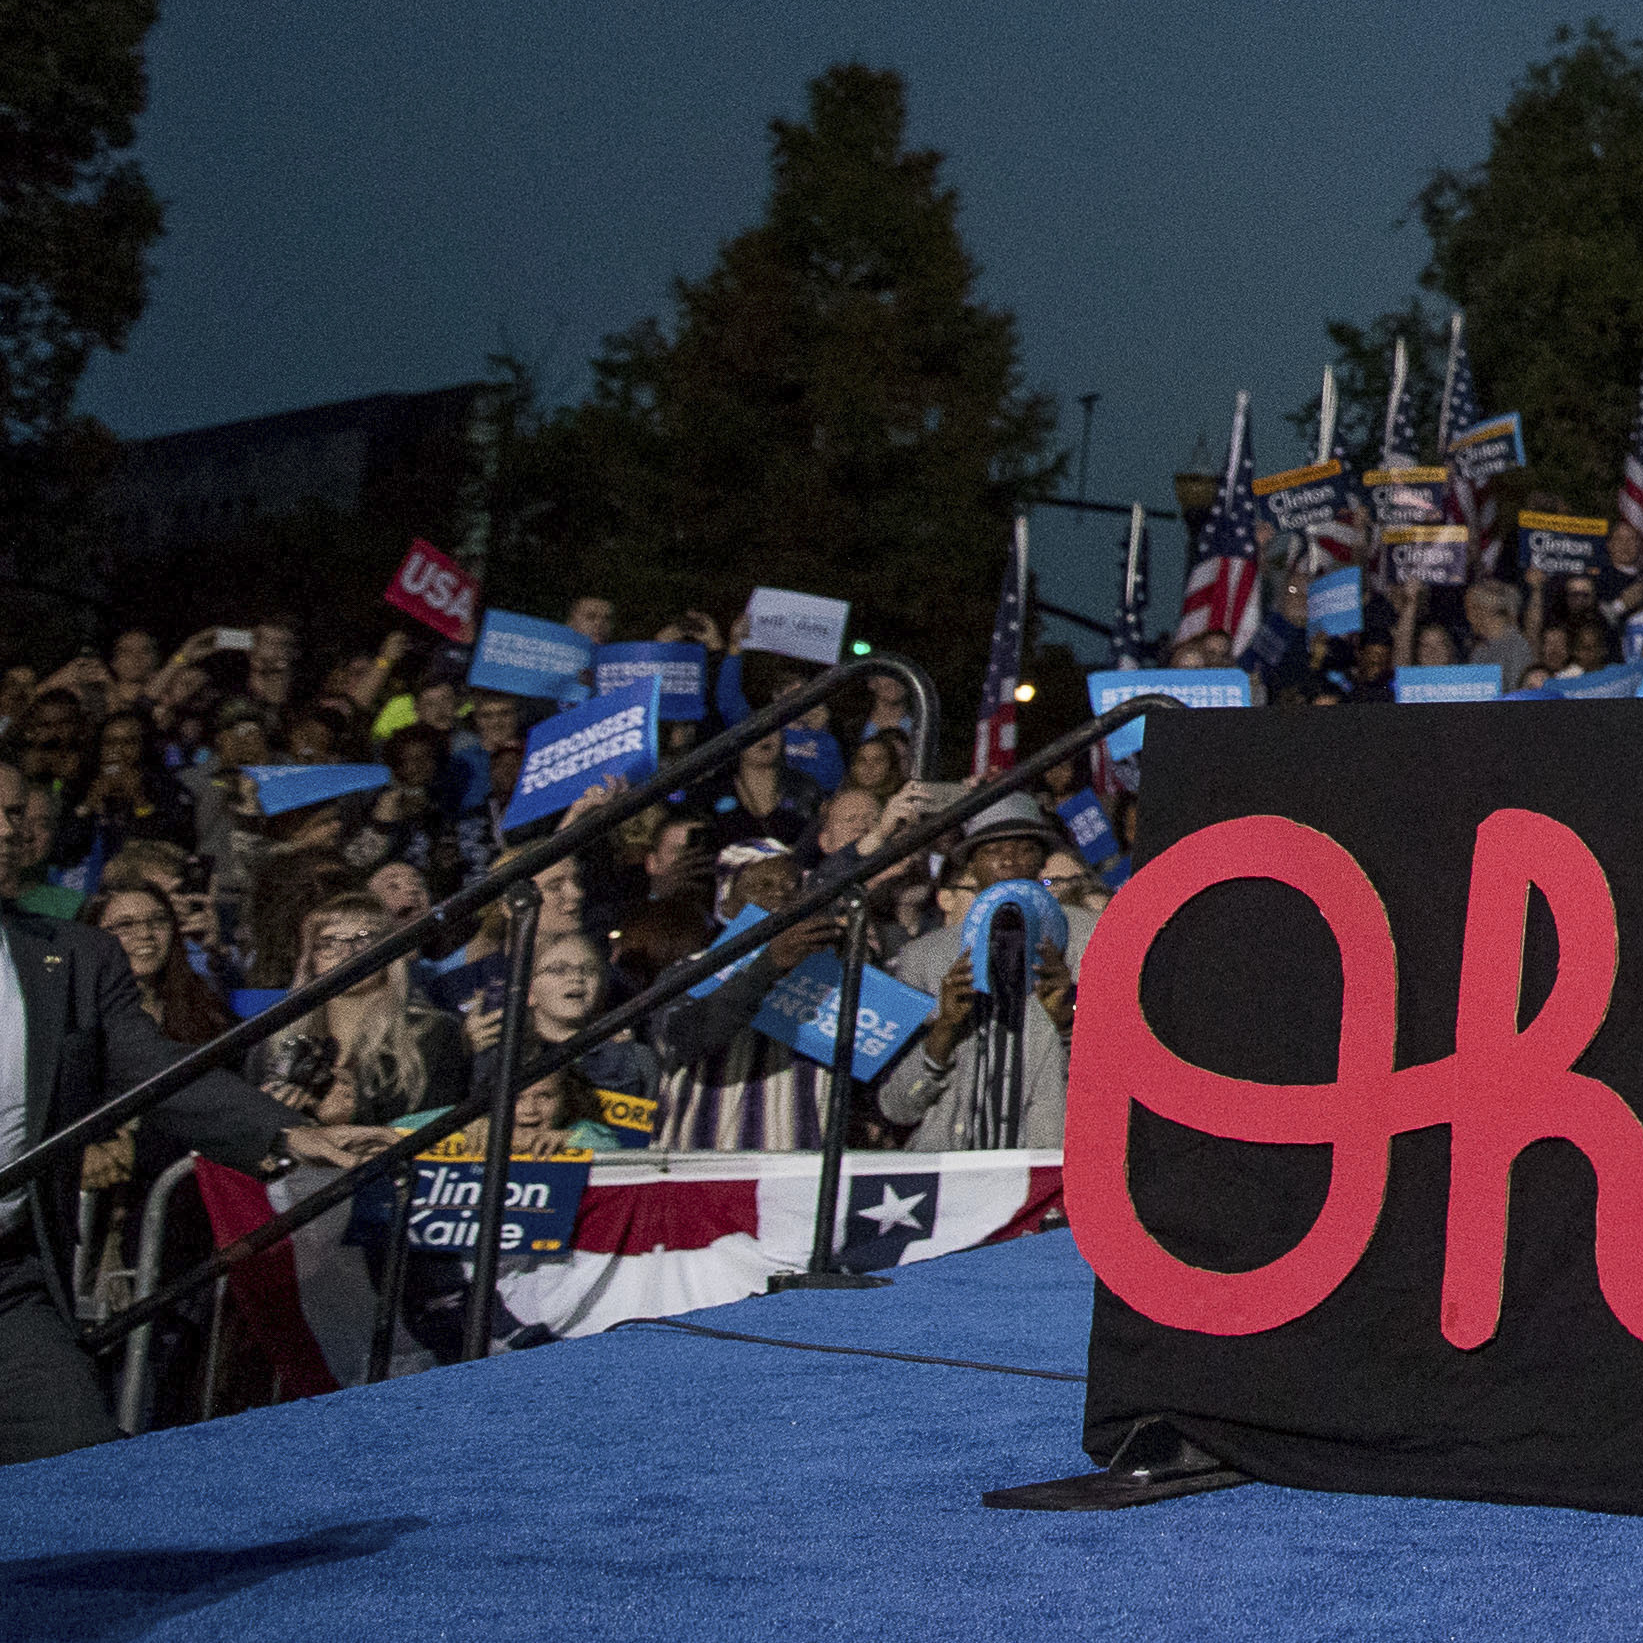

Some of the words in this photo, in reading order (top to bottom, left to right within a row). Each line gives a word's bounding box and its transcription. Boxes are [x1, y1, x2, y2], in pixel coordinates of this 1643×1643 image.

[400, 553, 474, 622] USA
[521, 729, 644, 796] TOGETHER
[525, 706, 646, 773] STRONGER
